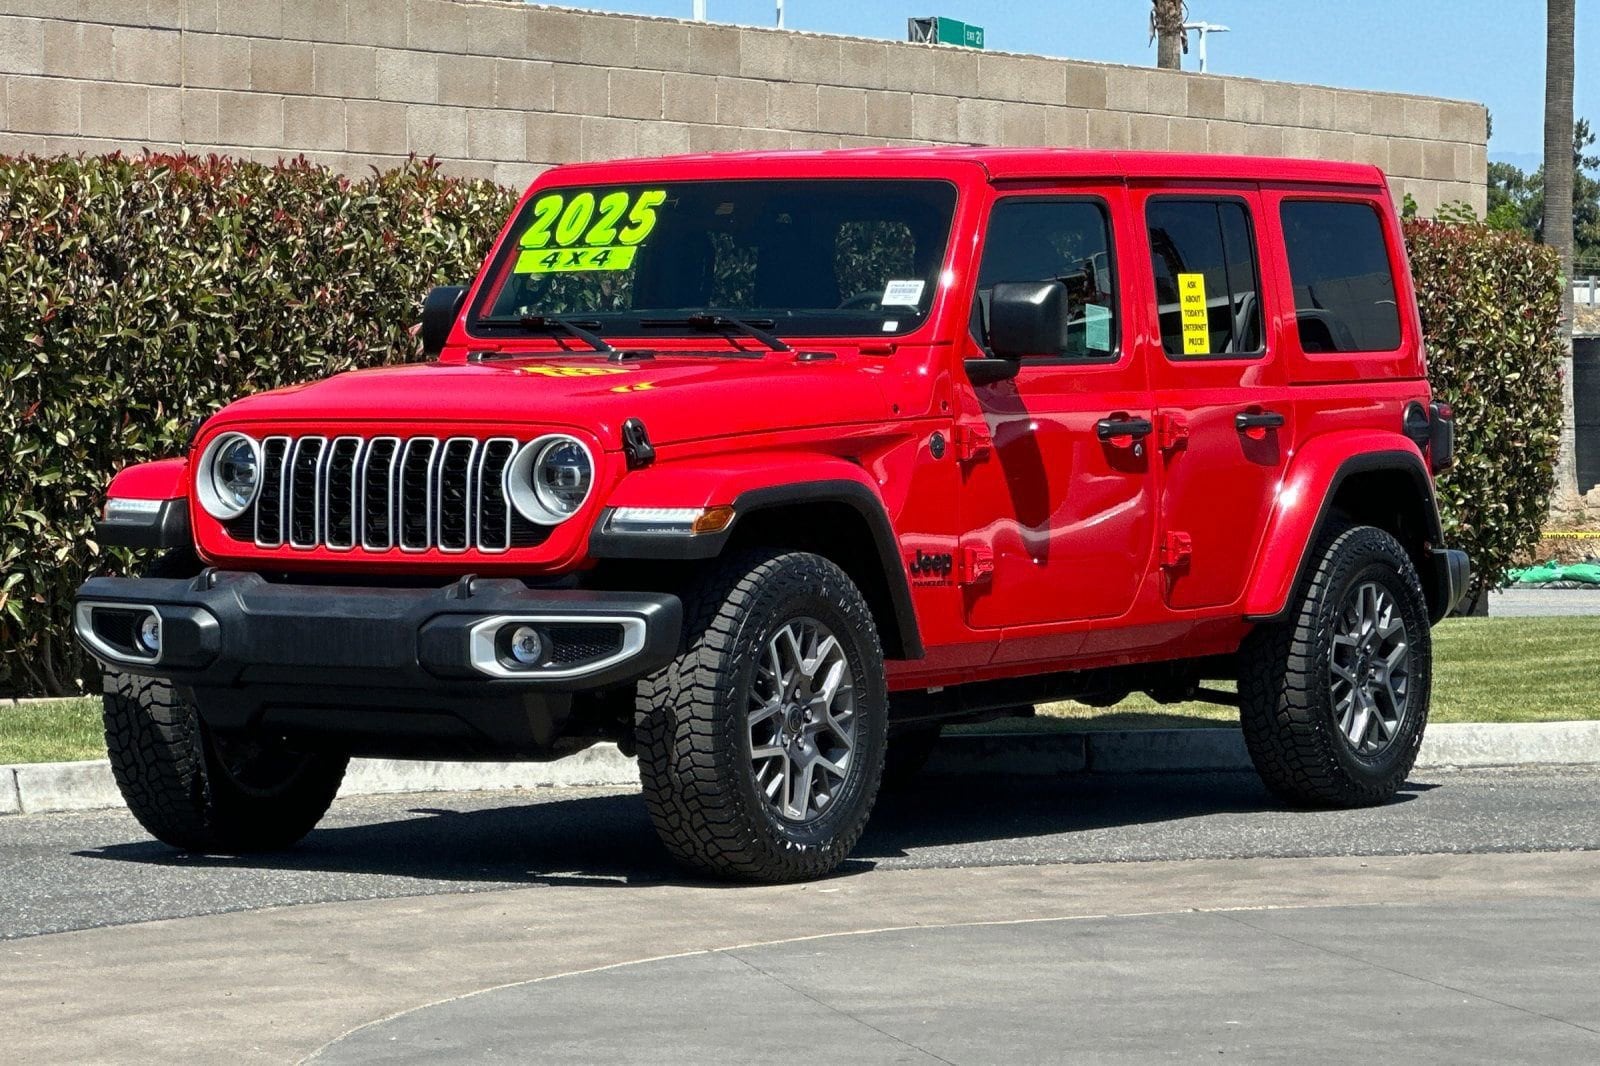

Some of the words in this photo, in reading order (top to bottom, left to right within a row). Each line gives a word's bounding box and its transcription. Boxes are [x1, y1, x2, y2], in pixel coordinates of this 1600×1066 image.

[520, 190, 667, 248] 2025
[1187, 281, 1197, 289] ASK
[1185, 295, 1201, 303] ABOUT
[1184, 309, 1205, 318] TODAY'S
[1184, 323, 1207, 332] INTERNET
[909, 549, 953, 576] Jeep
